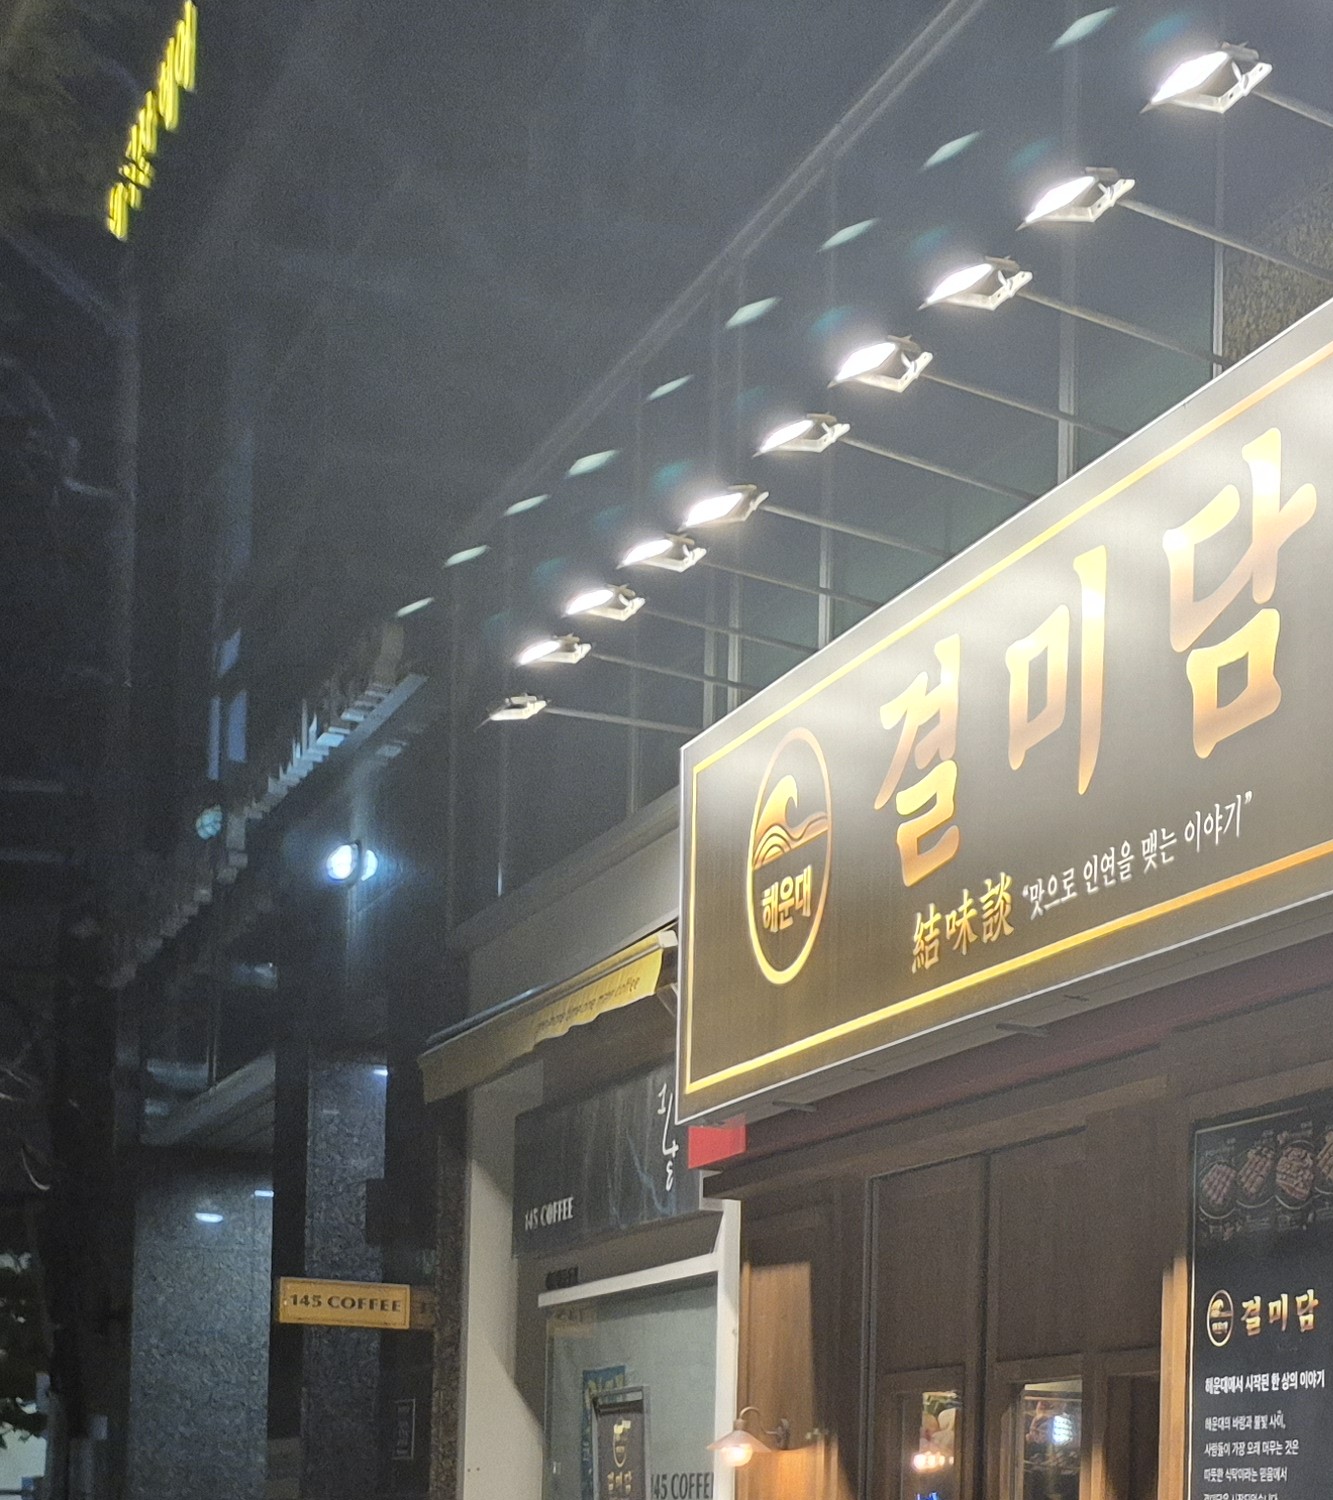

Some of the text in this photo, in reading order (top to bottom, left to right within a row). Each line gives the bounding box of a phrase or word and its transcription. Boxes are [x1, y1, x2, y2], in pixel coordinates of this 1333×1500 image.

[873, 428, 1318, 886] 결미담
[1082, 840, 1135, 890] 인연을
[1139, 825, 1178, 873] 맺는
[761, 865, 812, 934] 해운대
[911, 872, 1015, 973] 結味談
[540, 1196, 574, 1226] COFFEE
[290, 1294, 401, 1312] 145 COFFEE
[1240, 1289, 1318, 1337] 결미담
[1205, 1369, 1325, 1394] 해운대에서 시작된 한 상의 이야기
[1232, 1441, 1245, 1457] 가장
[1285, 1439, 1299, 1455] 것은
[671, 1472, 714, 1500] COFFE
